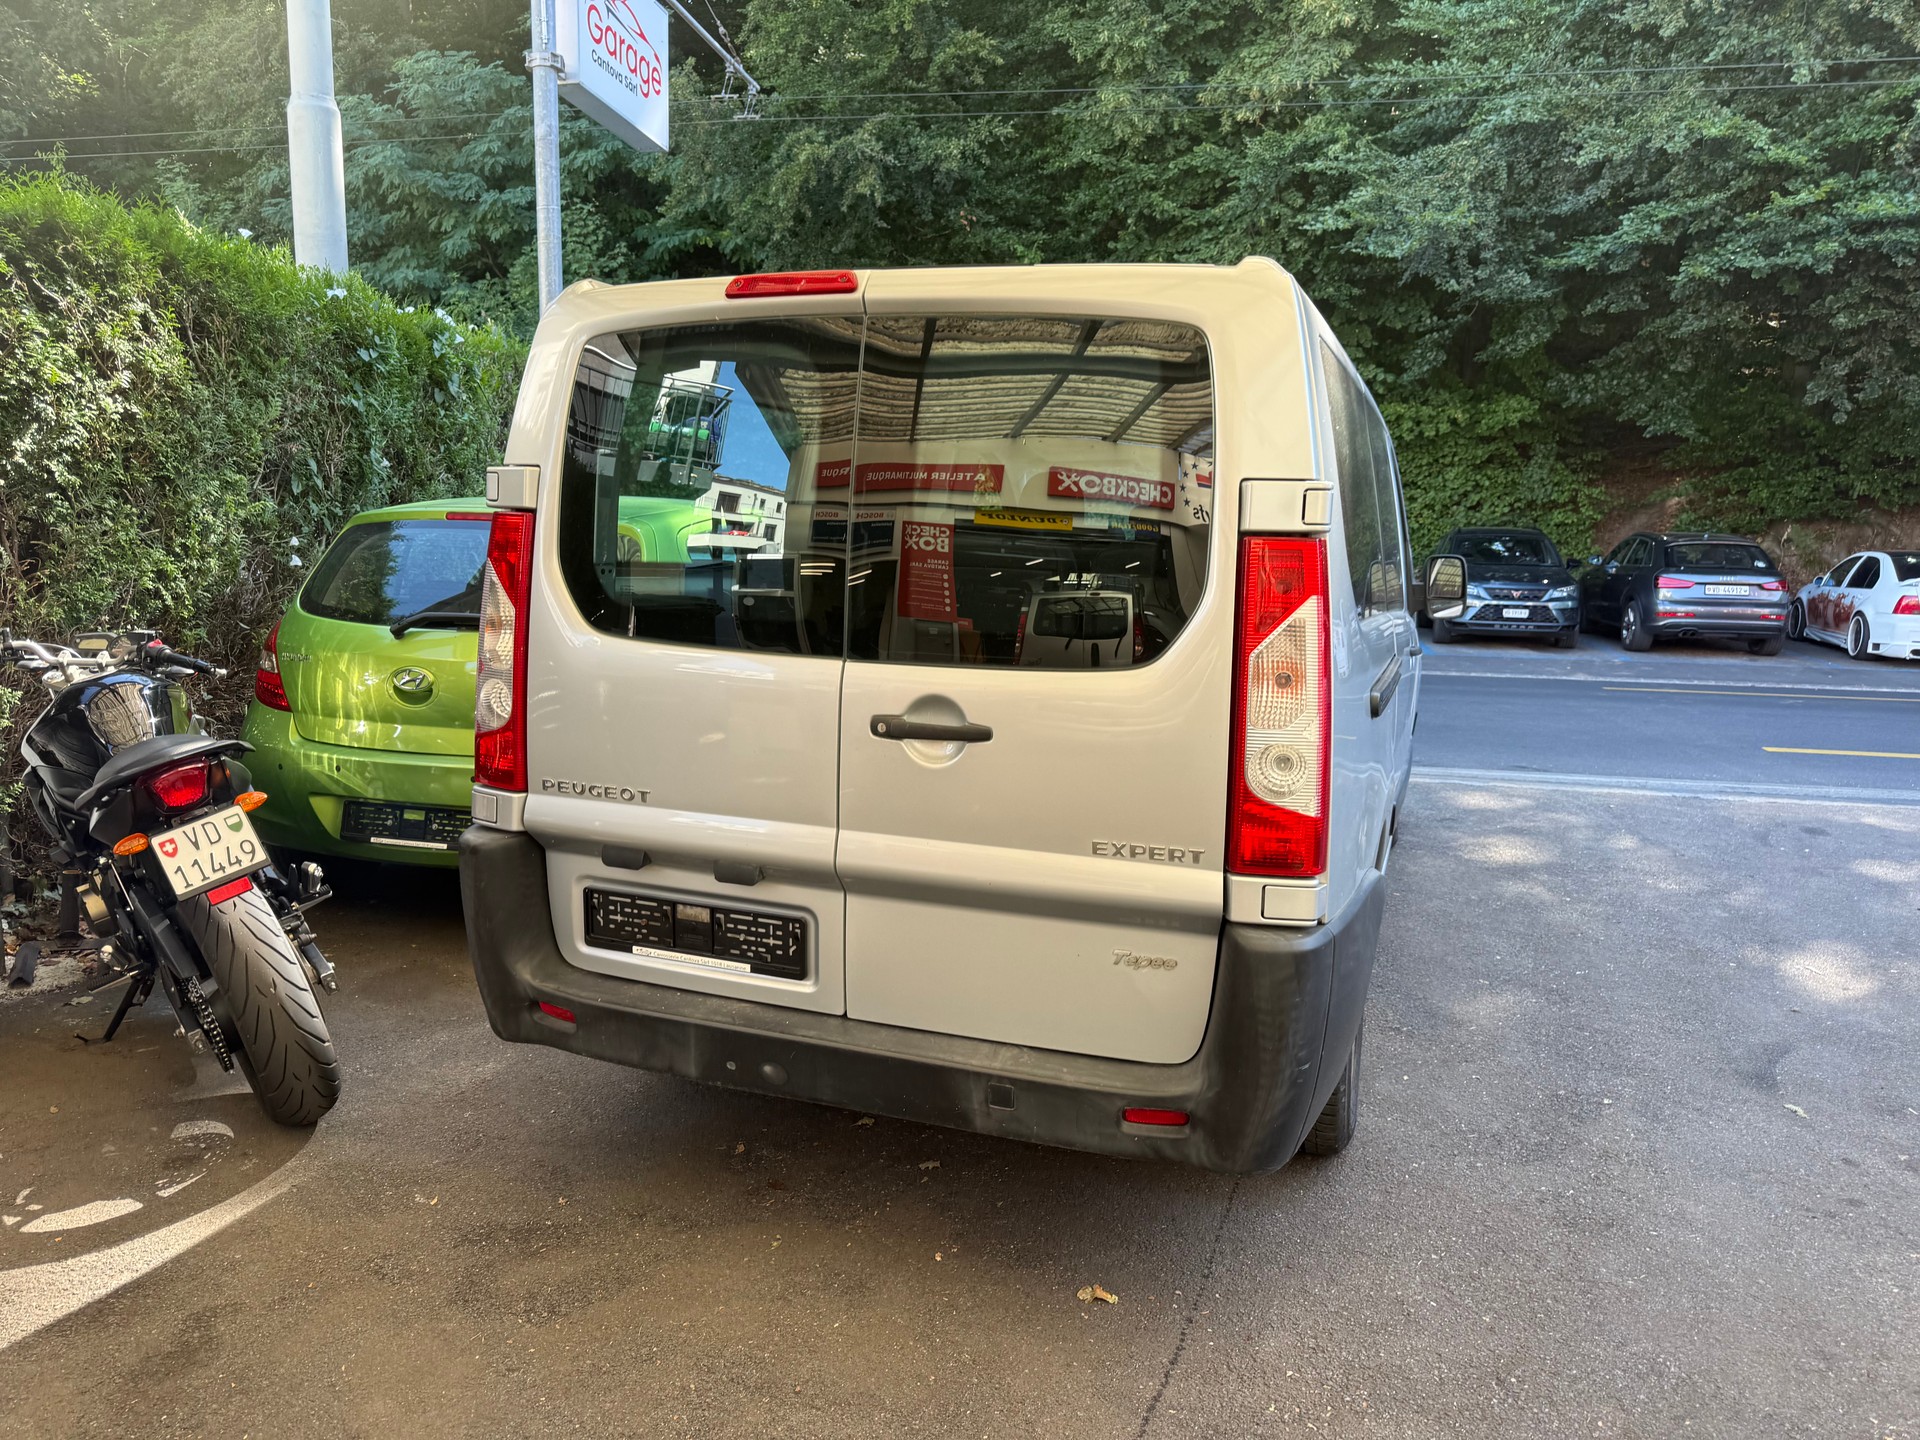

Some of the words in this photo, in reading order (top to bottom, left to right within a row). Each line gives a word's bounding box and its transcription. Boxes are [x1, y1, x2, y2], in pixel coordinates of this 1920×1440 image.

[587, 4, 662, 99] Garage
[591, 49, 623, 84] Cantova
[624, 75, 638, 96] Sàrl
[541, 778, 651, 803] PEUGEOT
[182, 821, 222, 851] VD
[174, 839, 256, 889] 11449
[1091, 839, 1205, 865] EXPERT
[1112, 949, 1178, 970] Tepee
